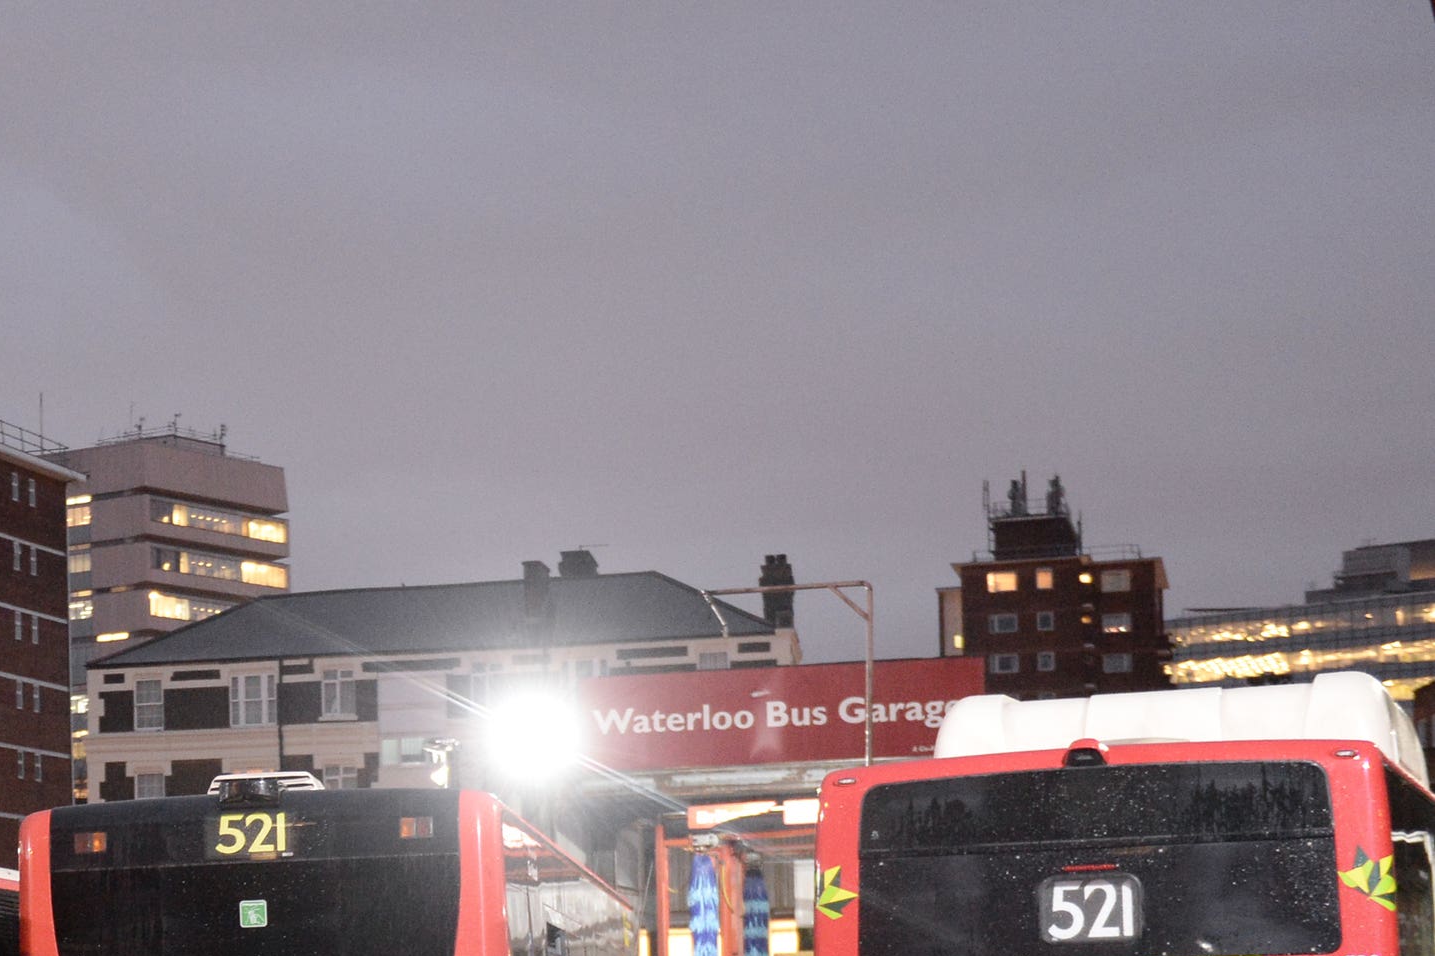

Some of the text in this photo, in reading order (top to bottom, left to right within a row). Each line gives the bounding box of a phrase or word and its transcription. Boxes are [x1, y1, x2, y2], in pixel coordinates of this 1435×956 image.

[592, 704, 755, 735] Waterloo
[766, 701, 827, 728] Bus
[215, 812, 286, 854] 521
[1048, 880, 1134, 940] 521
